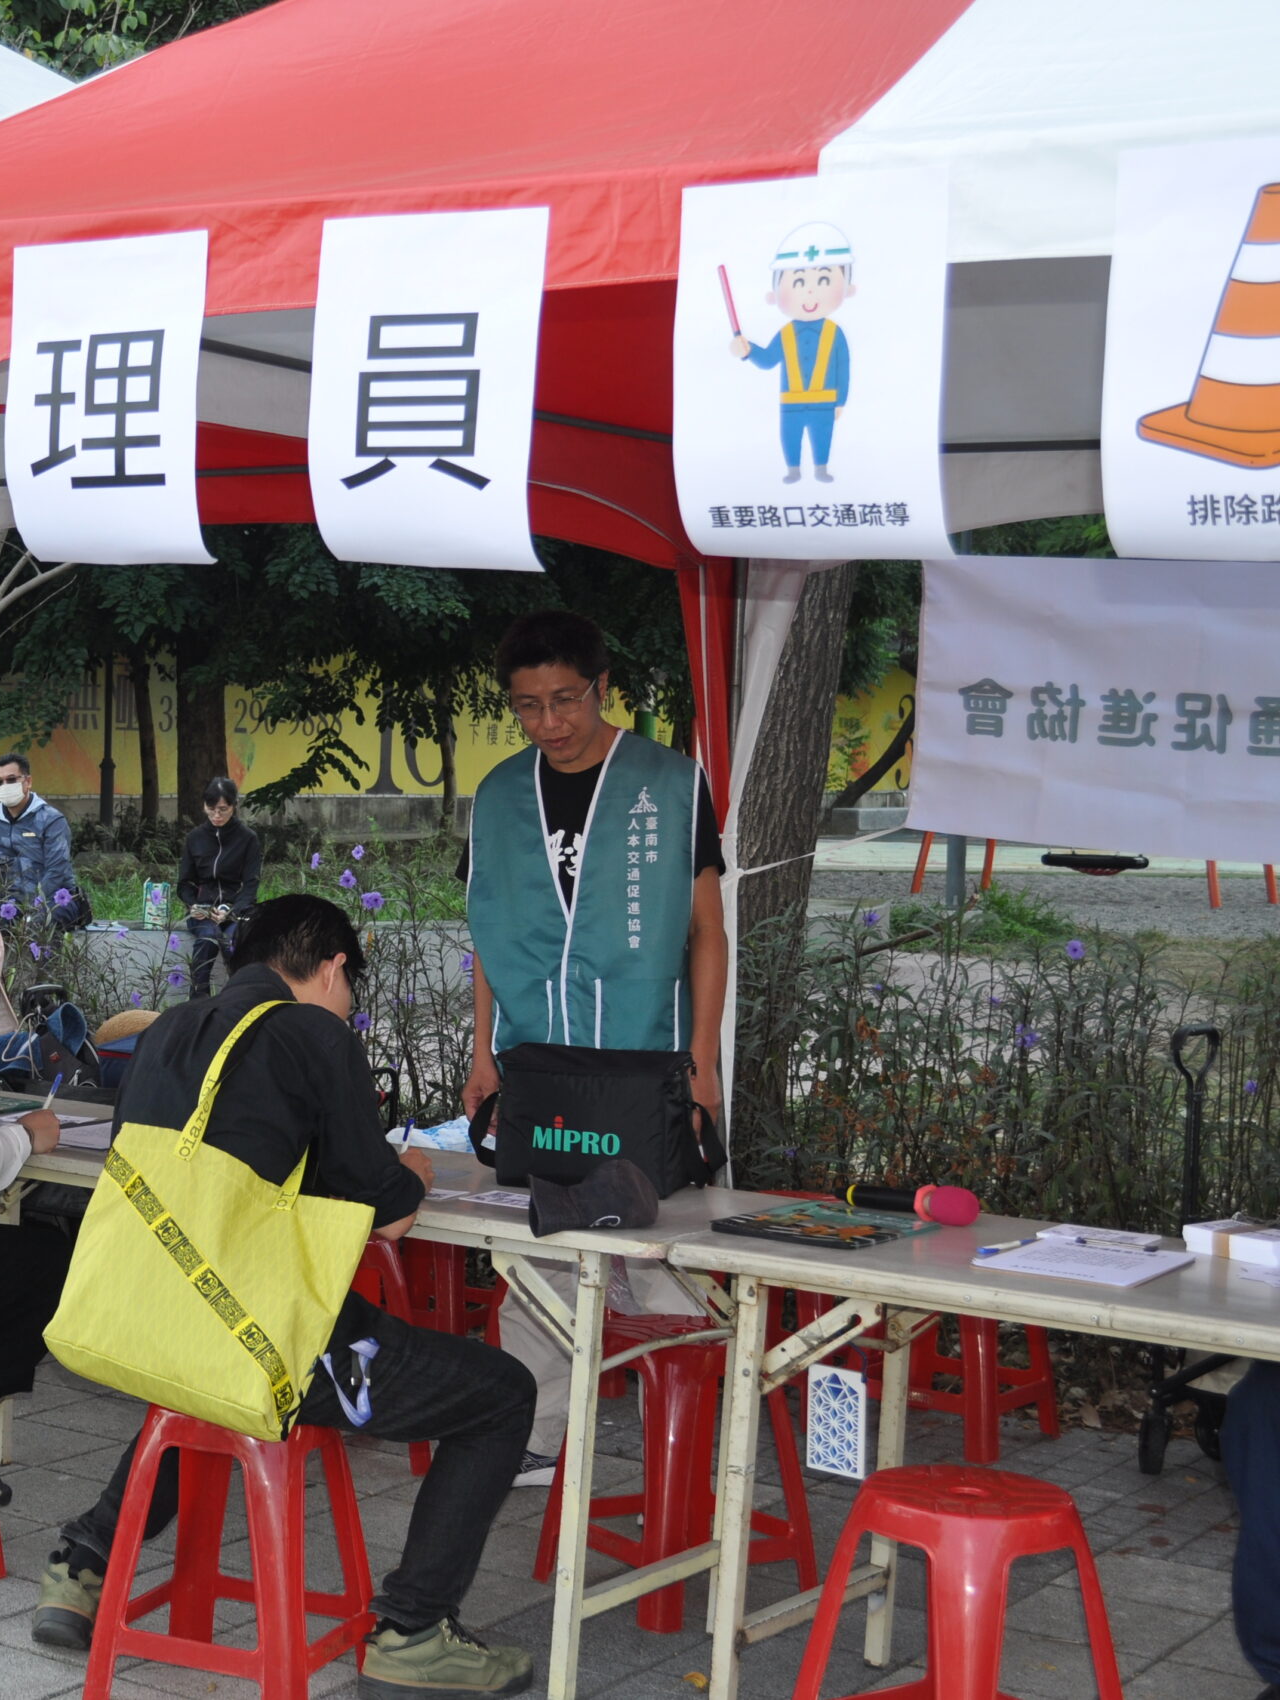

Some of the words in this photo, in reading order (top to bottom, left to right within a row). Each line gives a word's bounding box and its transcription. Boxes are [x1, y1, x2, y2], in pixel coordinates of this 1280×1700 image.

[708, 501, 910, 529] 重要路口交通疏導
[645, 816, 659, 863] 臺南市
[626, 817, 641, 949] 人本交通促進協會
